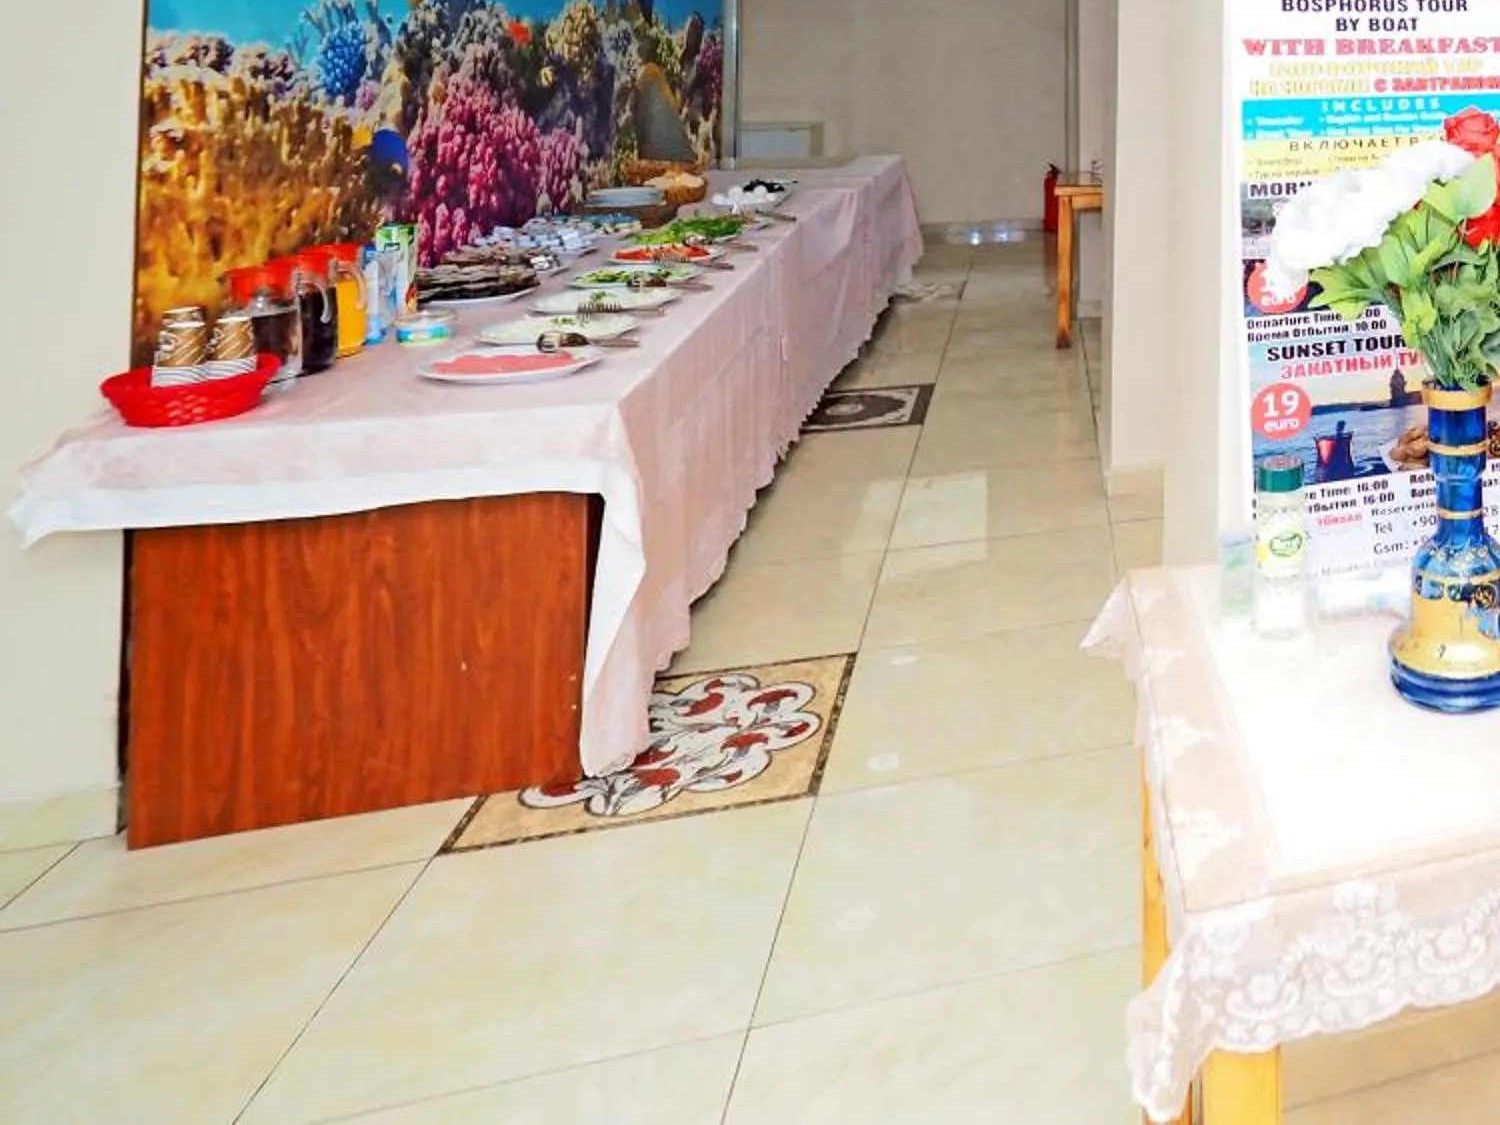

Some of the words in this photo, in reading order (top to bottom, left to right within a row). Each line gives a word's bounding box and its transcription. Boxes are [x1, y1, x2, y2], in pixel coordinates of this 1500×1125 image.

[1335, 17, 1360, 32] BY
[1369, 17, 1419, 32] BOAT
[1242, 38, 1325, 56] WITH
[1321, 97, 1441, 113] INCLUDES
[1247, 315, 1310, 331] Departure
[1267, 339, 1347, 362] SUNSET
[1353, 334, 1407, 352] TOUR
[1263, 390, 1300, 417] 19
[1263, 418, 1300, 433] euro
